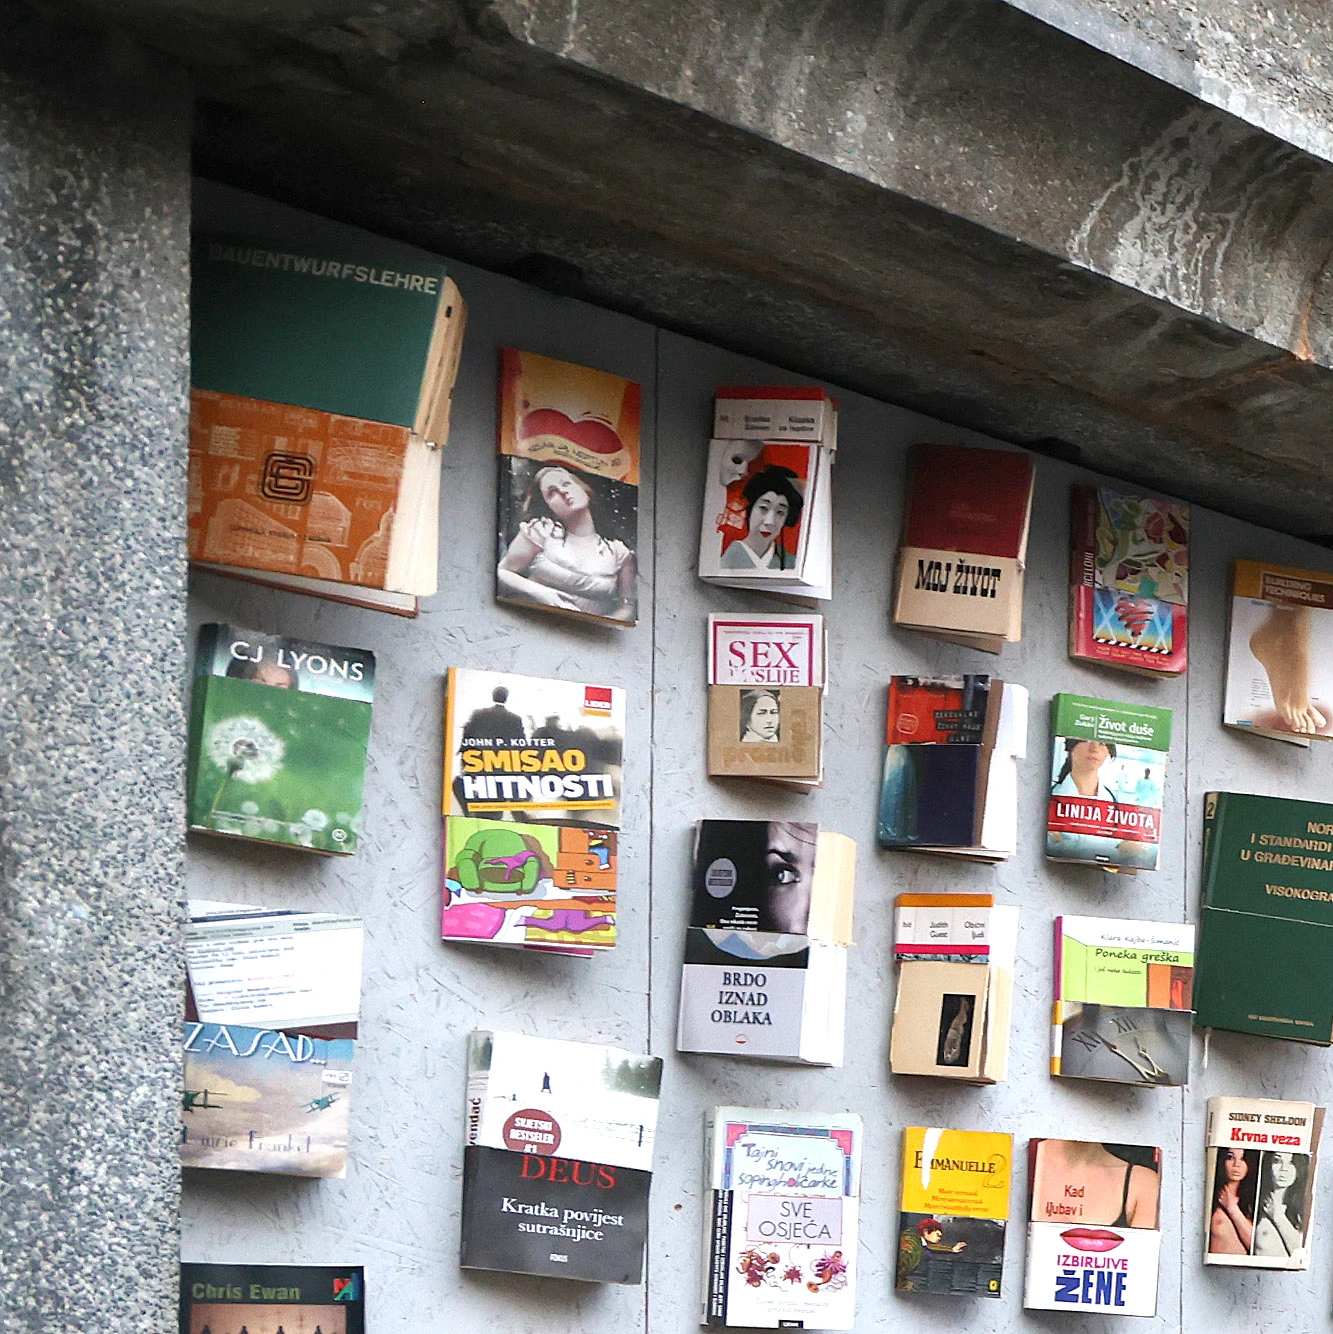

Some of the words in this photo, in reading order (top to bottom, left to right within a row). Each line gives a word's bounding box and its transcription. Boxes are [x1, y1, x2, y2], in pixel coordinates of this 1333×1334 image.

[915, 559, 951, 593] MOJ
[953, 558, 1001, 598] ŽIVOT
[229, 641, 264, 664] CJ
[277, 652, 365, 682] LYONS
[728, 640, 799, 669] SEX
[1098, 715, 1126, 732] Život
[1129, 719, 1155, 736] duše
[462, 738, 493, 748] JOHN
[496, 738, 507, 748] P.
[511, 738, 556, 748] KOTTER
[462, 748, 587, 773] SMISAO
[462, 774, 614, 799] HITNOSTI
[1056, 802, 1102, 822] LINIJA
[1106, 804, 1154, 829] ŽIVOTA
[1250, 833, 1256, 844] I
[1259, 834, 1333, 853] STANDARDI
[1240, 849, 1251, 861] U
[1095, 948, 1138, 961] Poneka
[1141, 951, 1180, 965] greška
[722, 972, 767, 988] BRDO
[718, 991, 768, 1007] IZNAD
[711, 1010, 772, 1026] OBLAKA
[1228, 1112, 1262, 1124] SIDNEY
[1264, 1115, 1307, 1127] SHELDON
[1230, 1127, 1268, 1144] Krvna
[1271, 1134, 1301, 1147] veza
[520, 1154, 617, 1190] DEUS
[1064, 1185, 1085, 1198] Kad
[501, 1197, 559, 1218] Kratka
[563, 1206, 624, 1227] povijest
[779, 1200, 812, 1218] SVE
[1045, 1202, 1076, 1217] ljubav
[1079, 1204, 1083, 1216] i
[517, 1221, 604, 1243] sutrašnjice
[758, 1220, 831, 1242] OSJEĆA
[1057, 1254, 1128, 1270] IZBIRLJIVE
[191, 1282, 243, 1300] Chris
[250, 1284, 301, 1300] Ewan
[1054, 1270, 1128, 1307] ŽENE
